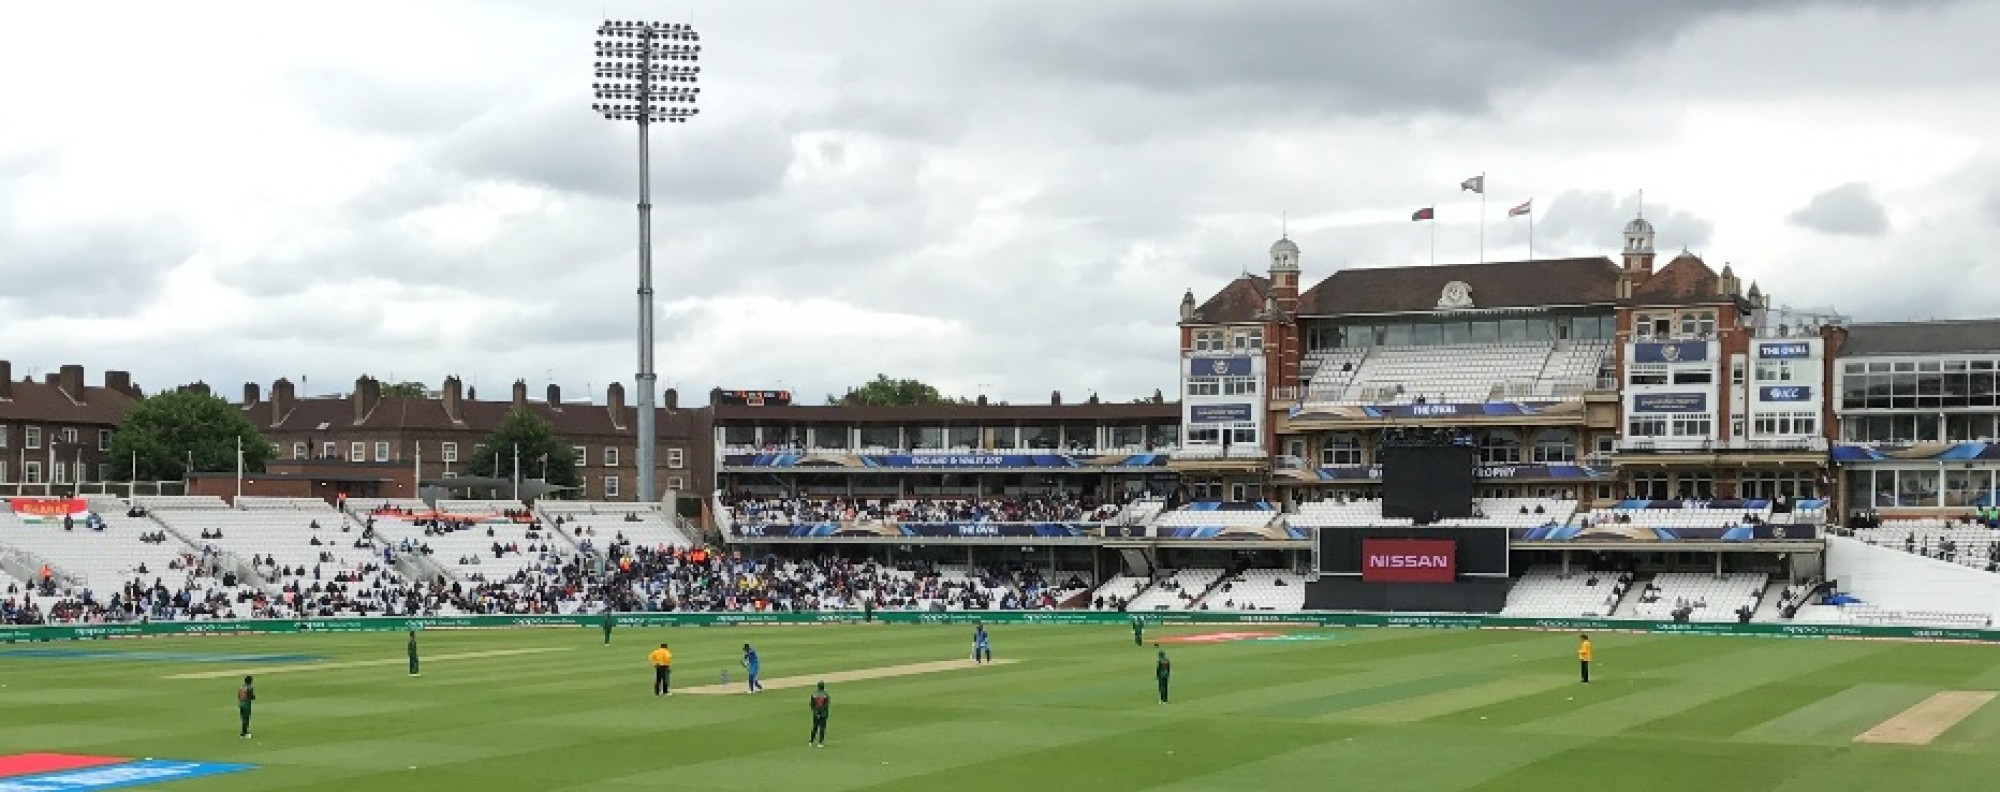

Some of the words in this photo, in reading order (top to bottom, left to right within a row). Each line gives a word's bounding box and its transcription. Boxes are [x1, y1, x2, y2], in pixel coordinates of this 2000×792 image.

[1762, 347, 1779, 355] THE
[1780, 345, 1807, 355] OVAL
[1413, 405, 1430, 415] THE
[1431, 405, 1457, 415] OVAL
[958, 525, 975, 535] THE
[975, 525, 999, 535] OVAL
[1370, 555, 1448, 568] NISSAN
